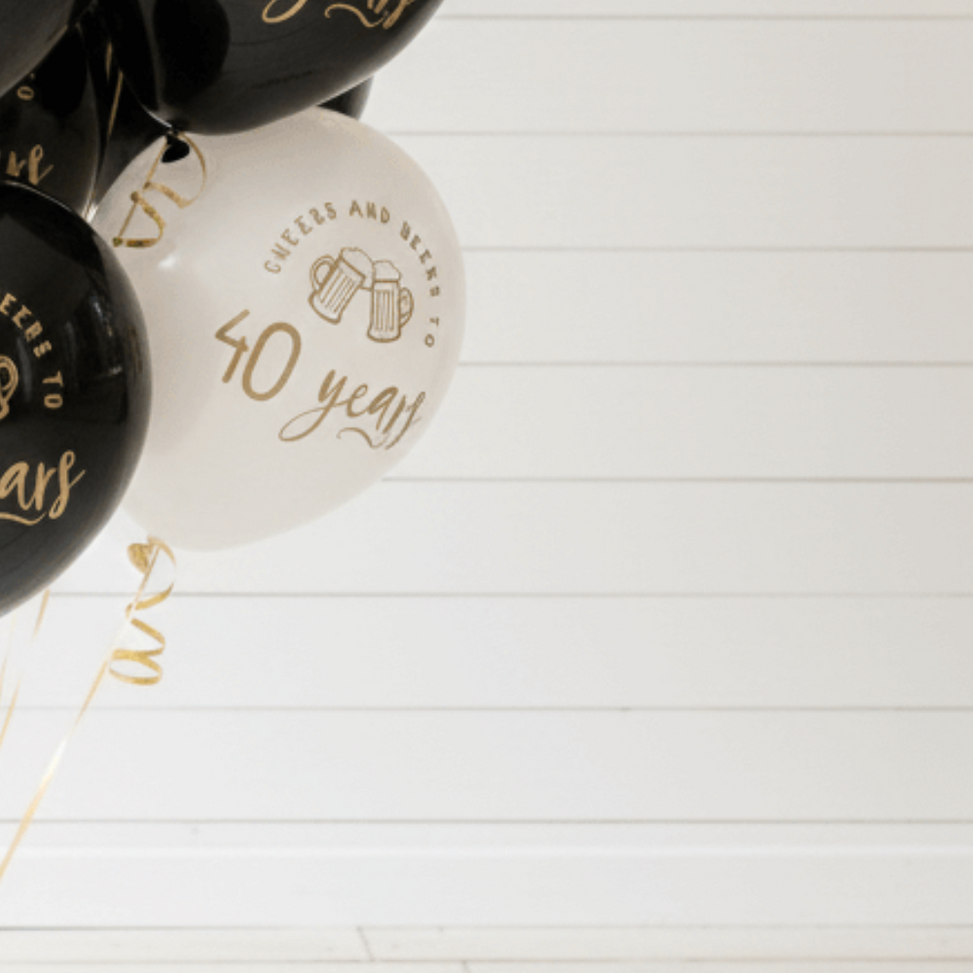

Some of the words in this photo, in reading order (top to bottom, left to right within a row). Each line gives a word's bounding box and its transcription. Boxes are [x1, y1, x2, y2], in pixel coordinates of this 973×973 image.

[263, 201, 337, 274] CHEERS
[349, 199, 391, 224] AND
[400, 220, 441, 297] BEERS
[424, 316, 440, 348] TO
[41, 371, 64, 409] TO
[214, 308, 301, 402] 40
[278, 369, 426, 450] years
